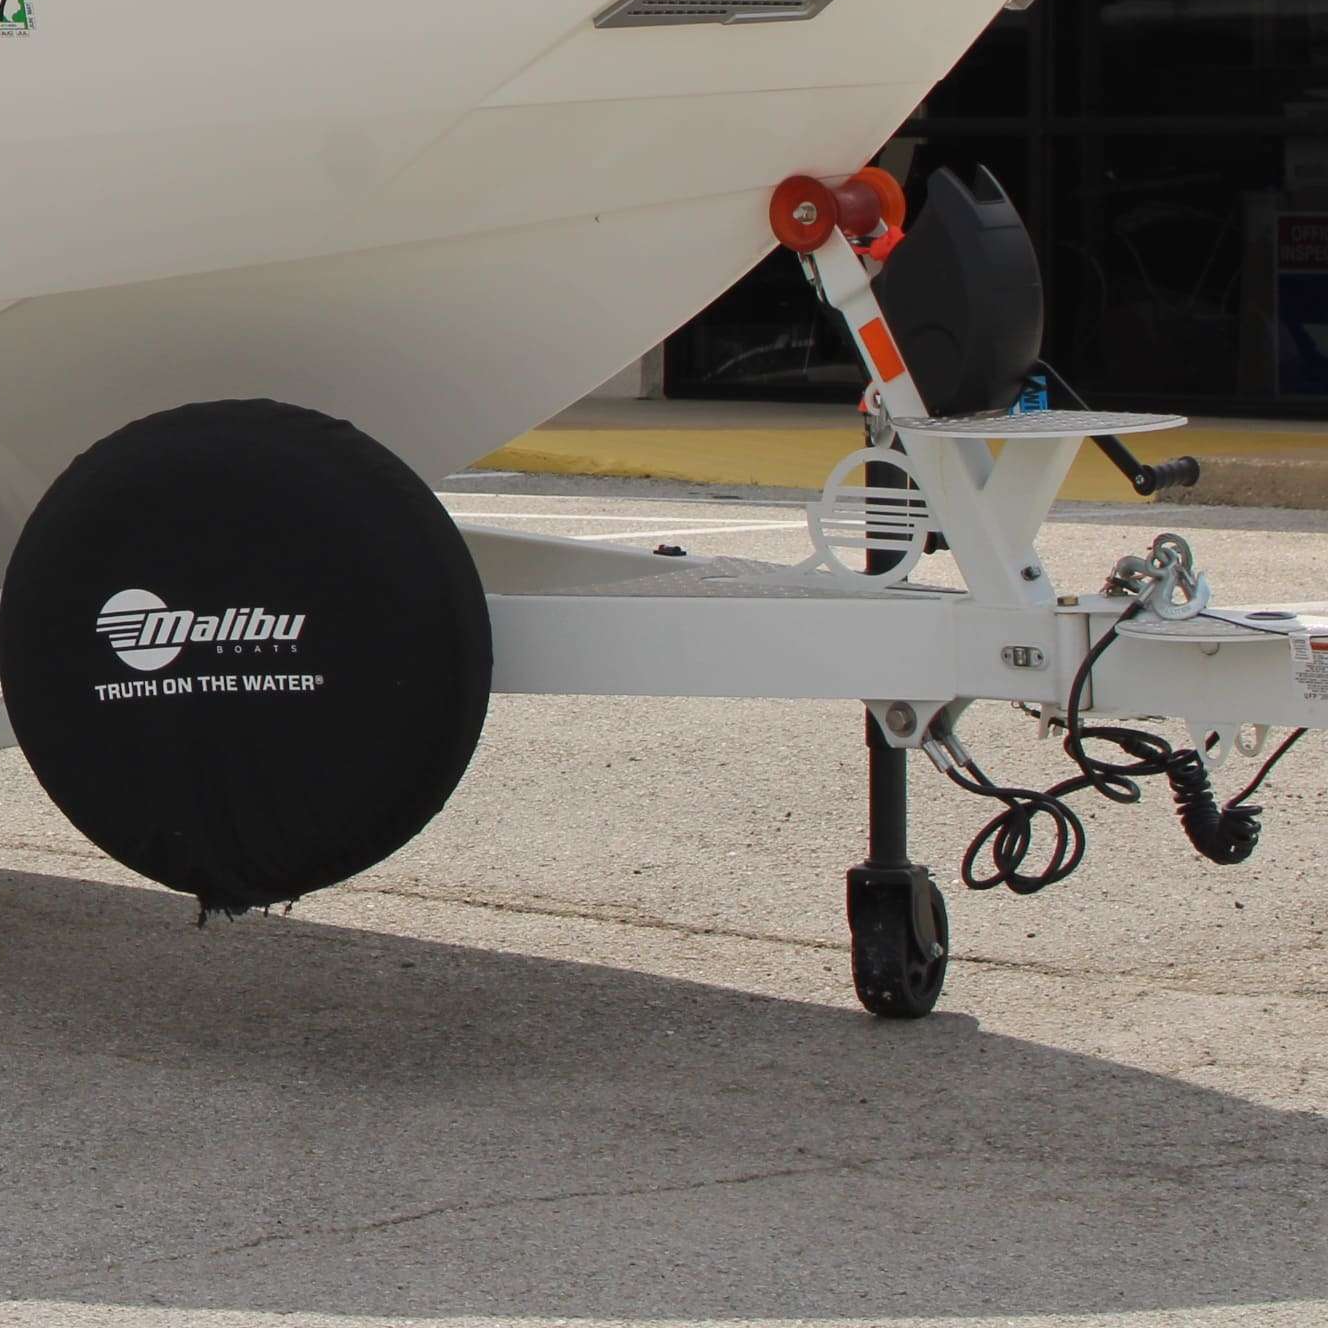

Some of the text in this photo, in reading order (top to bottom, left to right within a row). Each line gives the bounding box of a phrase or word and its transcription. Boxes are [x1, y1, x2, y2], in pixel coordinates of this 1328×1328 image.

[216, 645, 297, 654] BOATS
[95, 680, 157, 701] TRUTH
[163, 677, 192, 695] ON
[197, 675, 238, 692] THE
